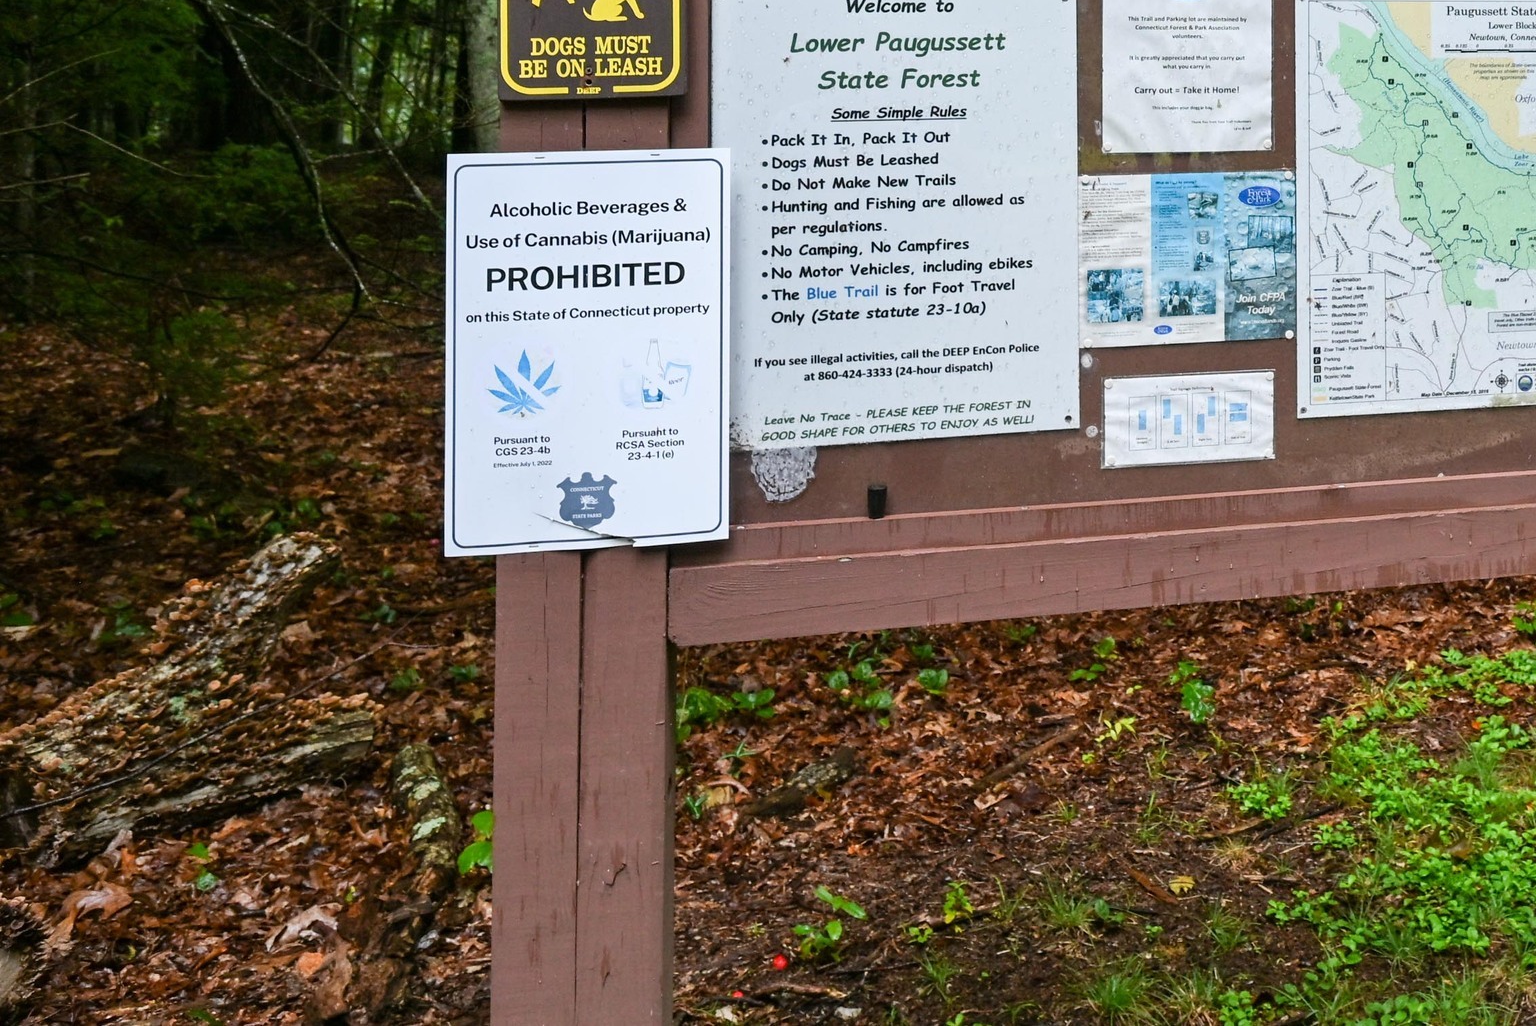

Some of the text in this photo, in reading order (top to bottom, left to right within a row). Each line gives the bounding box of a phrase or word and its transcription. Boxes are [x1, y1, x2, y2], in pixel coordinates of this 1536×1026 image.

[936, 0, 954, 13] to
[1447, 6, 1507, 17] Paugussett
[530, 36, 651, 56] DOGS MUST
[790, 32, 1006, 57] Lower Paugussett
[1469, 34, 1507, 42] Newtown,
[519, 57, 662, 78] BE ON LEASH
[817, 68, 981, 89] State Forest
[1134, 87, 1156, 95] Carry
[1212, 86, 1239, 94] Home!
[831, 105, 967, 121] Some Simple Rules
[771, 131, 950, 146] Pack It In, Pack It Out
[772, 153, 939, 171] Dogs Must Be Leashed
[490, 198, 687, 217] Alcoholic Beverages &
[772, 194, 1025, 214] Hunting and Fishing are allowed as
[466, 227, 711, 249] Use of Cannabis (Marijuana)
[772, 221, 887, 239] per regulations.
[772, 239, 969, 258] No Camping, No Campfires
[486, 262, 685, 292] PROHIBITED
[772, 258, 1033, 279] No Motor Vehicles, including ebikes
[772, 279, 1015, 301] The Blue Trail is for Foot Travel
[1236, 291, 1286, 303] Join CFPA
[466, 303, 710, 323] on this State of Connecticut property
[772, 301, 986, 325] Only (State statute 23-10a)
[1247, 305, 1276, 316] Today
[754, 343, 1040, 368] If you see illegal activities, call the DEEP EnCon Police
[804, 362, 994, 382] at 860-424-3333 (24-hour dispatch)
[764, 400, 1032, 426] Leave No Trace PLEASE KEEP THE FOREST IN
[494, 435, 550, 445] Pursuant to
[622, 428, 679, 438] Pursuant to
[496, 446, 551, 457] CGS 23-4b
[616, 438, 685, 450] RCSA Section
[627, 450, 674, 460] 23-4-1 (e)
[493, 461, 519, 469] Effective
[520, 461, 531, 469] July
